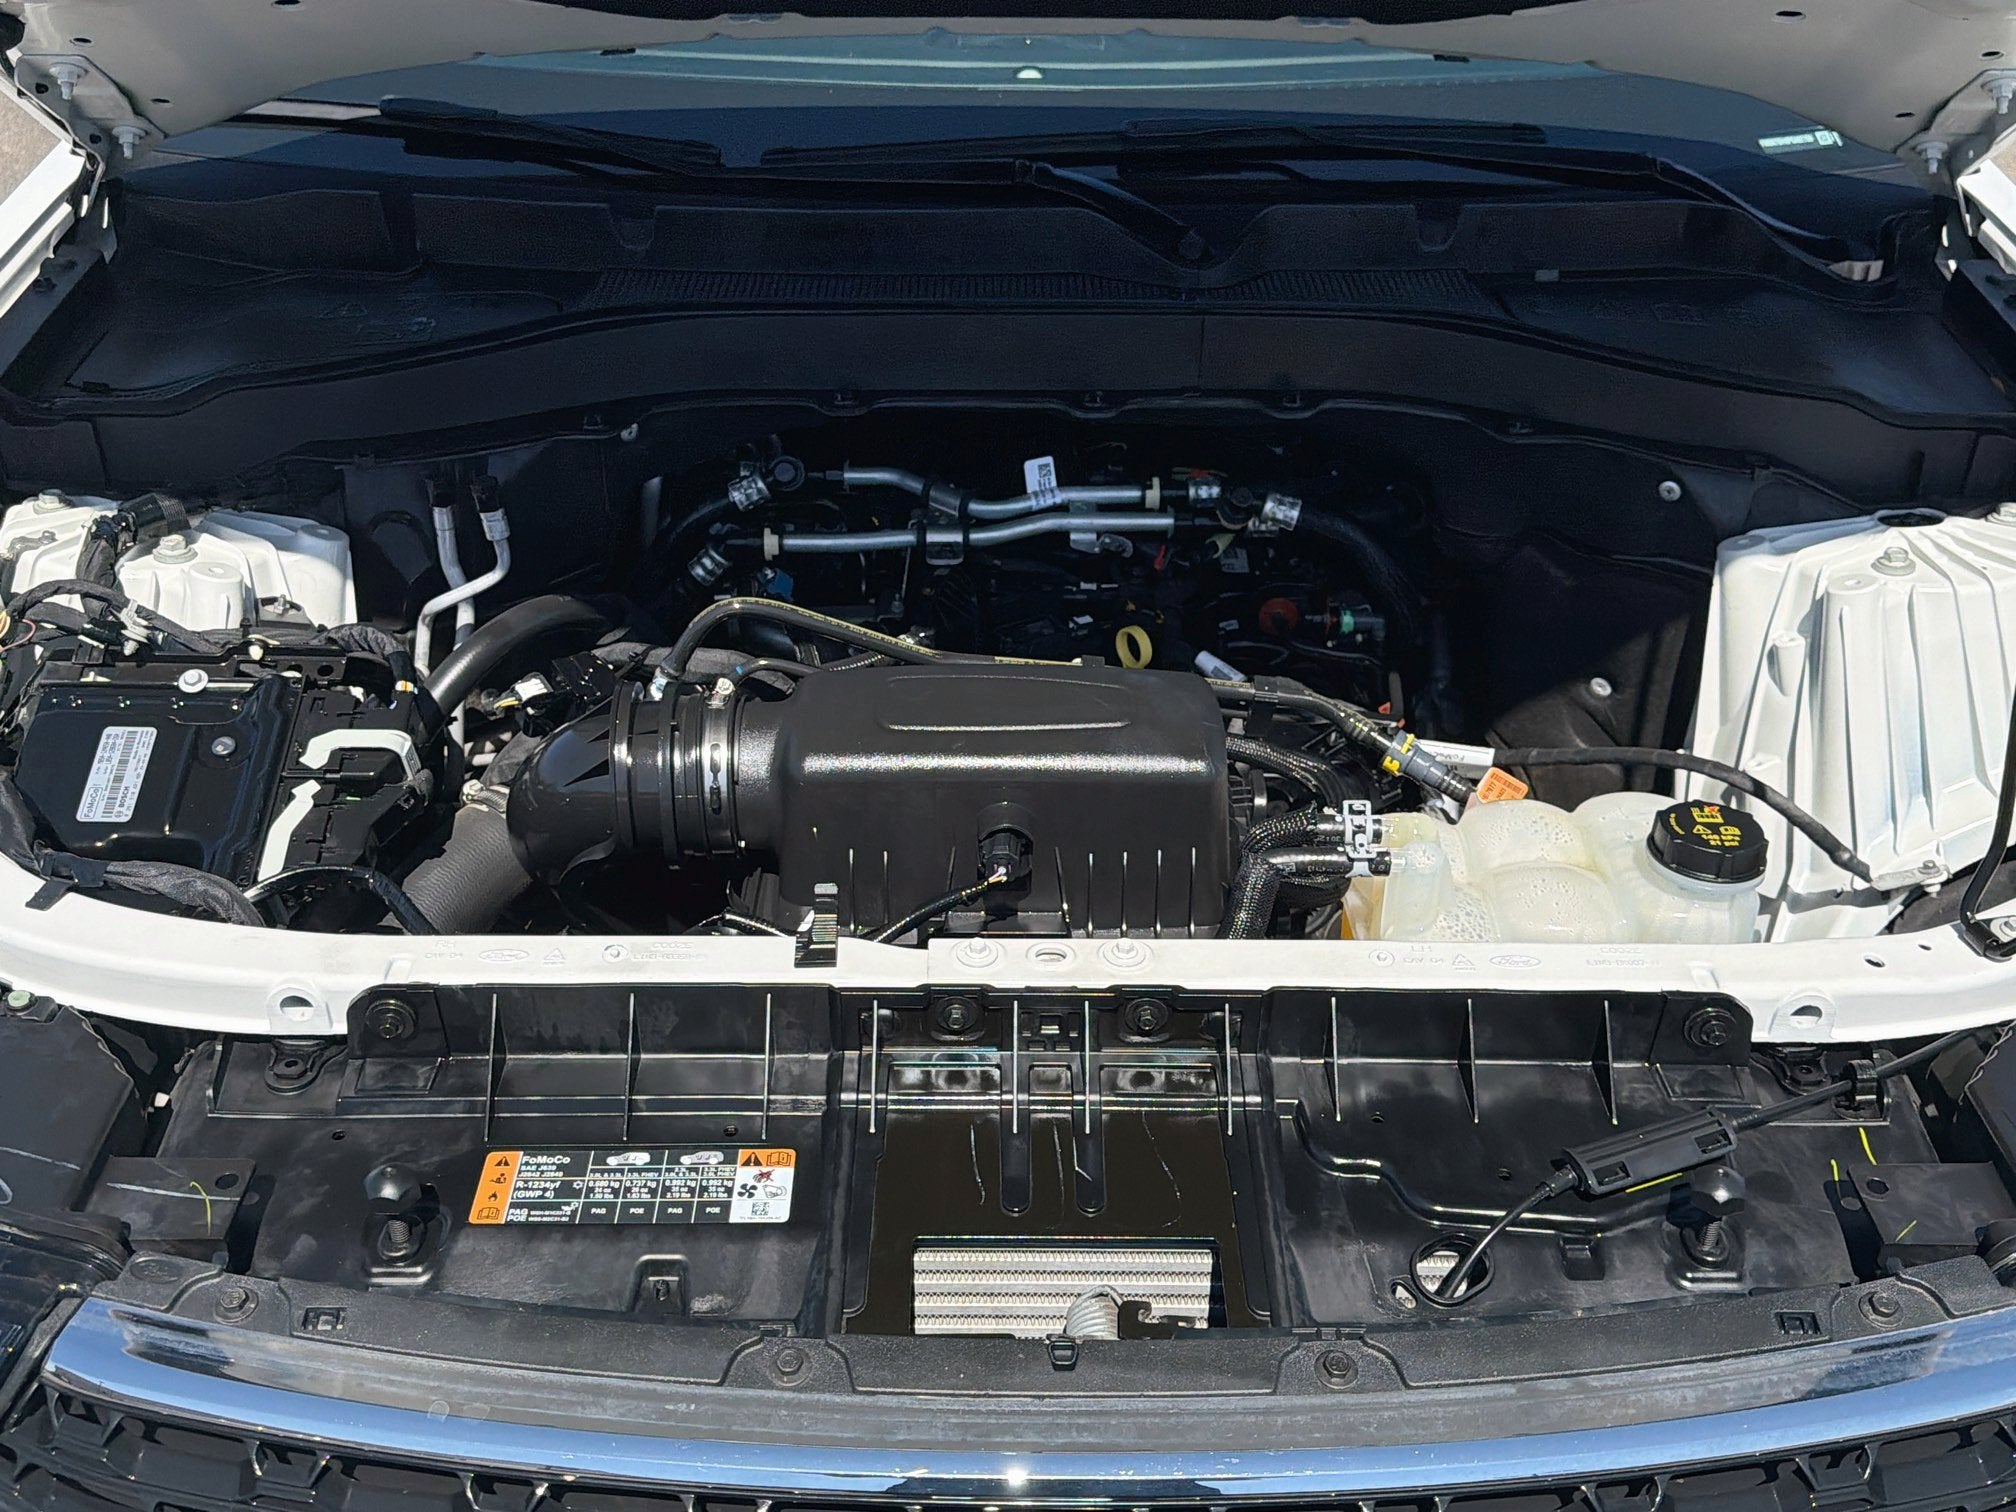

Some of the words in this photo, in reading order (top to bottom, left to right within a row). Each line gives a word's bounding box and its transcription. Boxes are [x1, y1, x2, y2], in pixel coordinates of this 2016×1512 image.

[118, 786, 130, 808] BOSCH
[84, 788, 100, 818] FoMoCo
[1496, 955, 1536, 967] Ford
[522, 1155, 571, 1164] FoMoCo
[516, 1181, 561, 1190] R-1234yf
[610, 1180, 620, 1188] kg
[647, 1180, 656, 1188] kg
[723, 1179, 733, 1187] kg
[513, 1190, 543, 1199] (GWP
[544, 1190, 554, 1199] 4)
